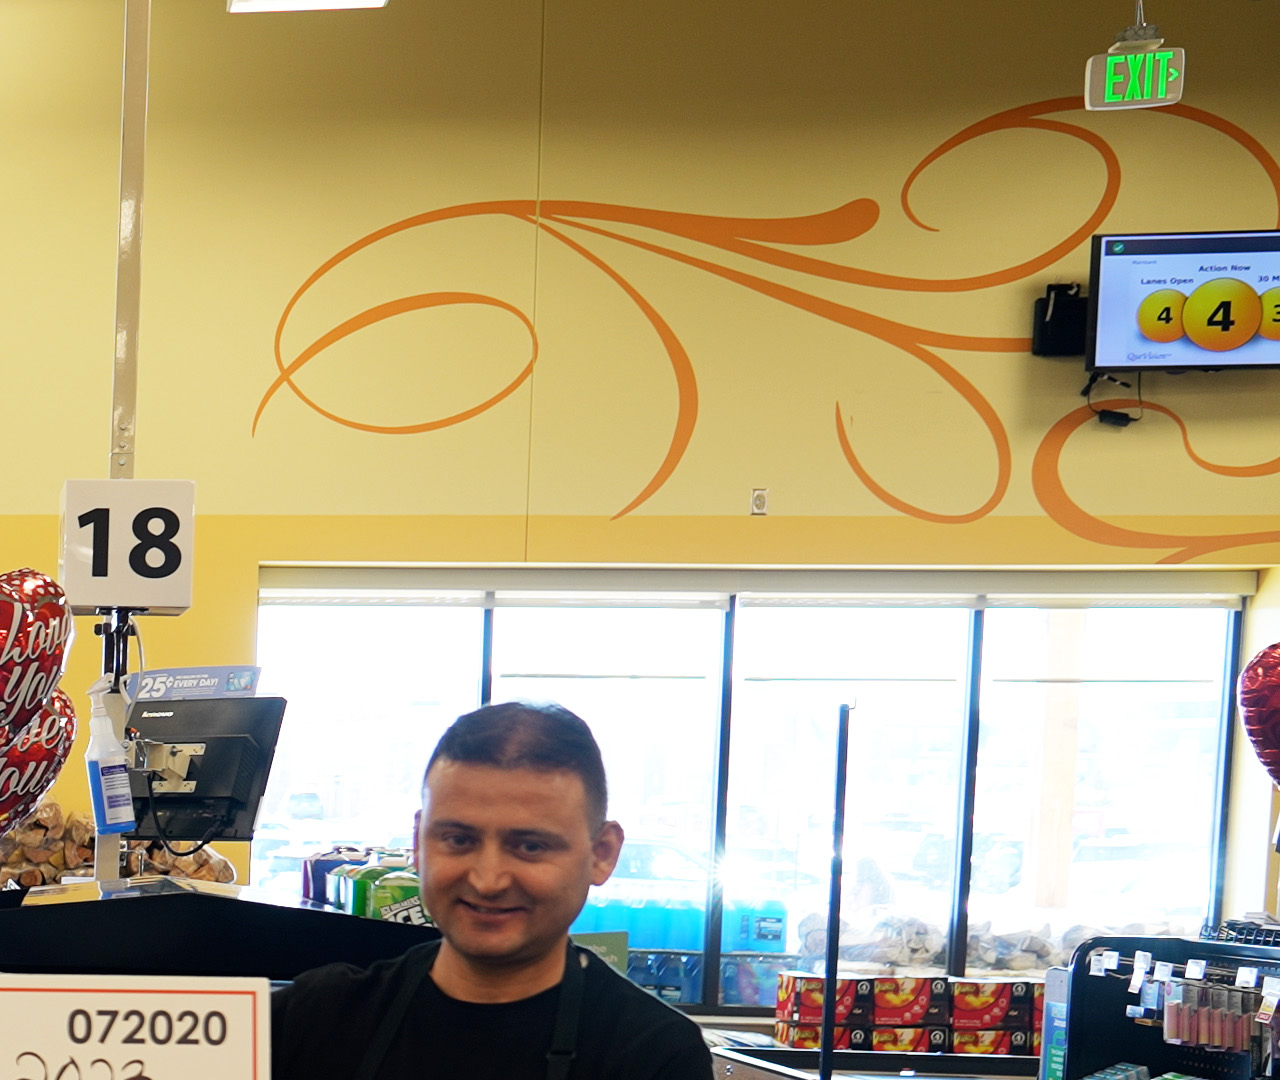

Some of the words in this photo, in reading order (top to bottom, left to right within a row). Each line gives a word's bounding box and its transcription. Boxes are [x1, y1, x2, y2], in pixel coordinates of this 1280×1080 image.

[1104, 51, 1175, 103] EXIT
[1198, 264, 1228, 273] Action
[1141, 277, 1168, 285] Lanes
[1170, 277, 1194, 286] Open
[1157, 307, 1173, 324] 4
[1206, 300, 1236, 332] 4
[76, 506, 183, 579] 18
[173, 678, 198, 688] EVERY
[66, 1008, 228, 1046] 072020
